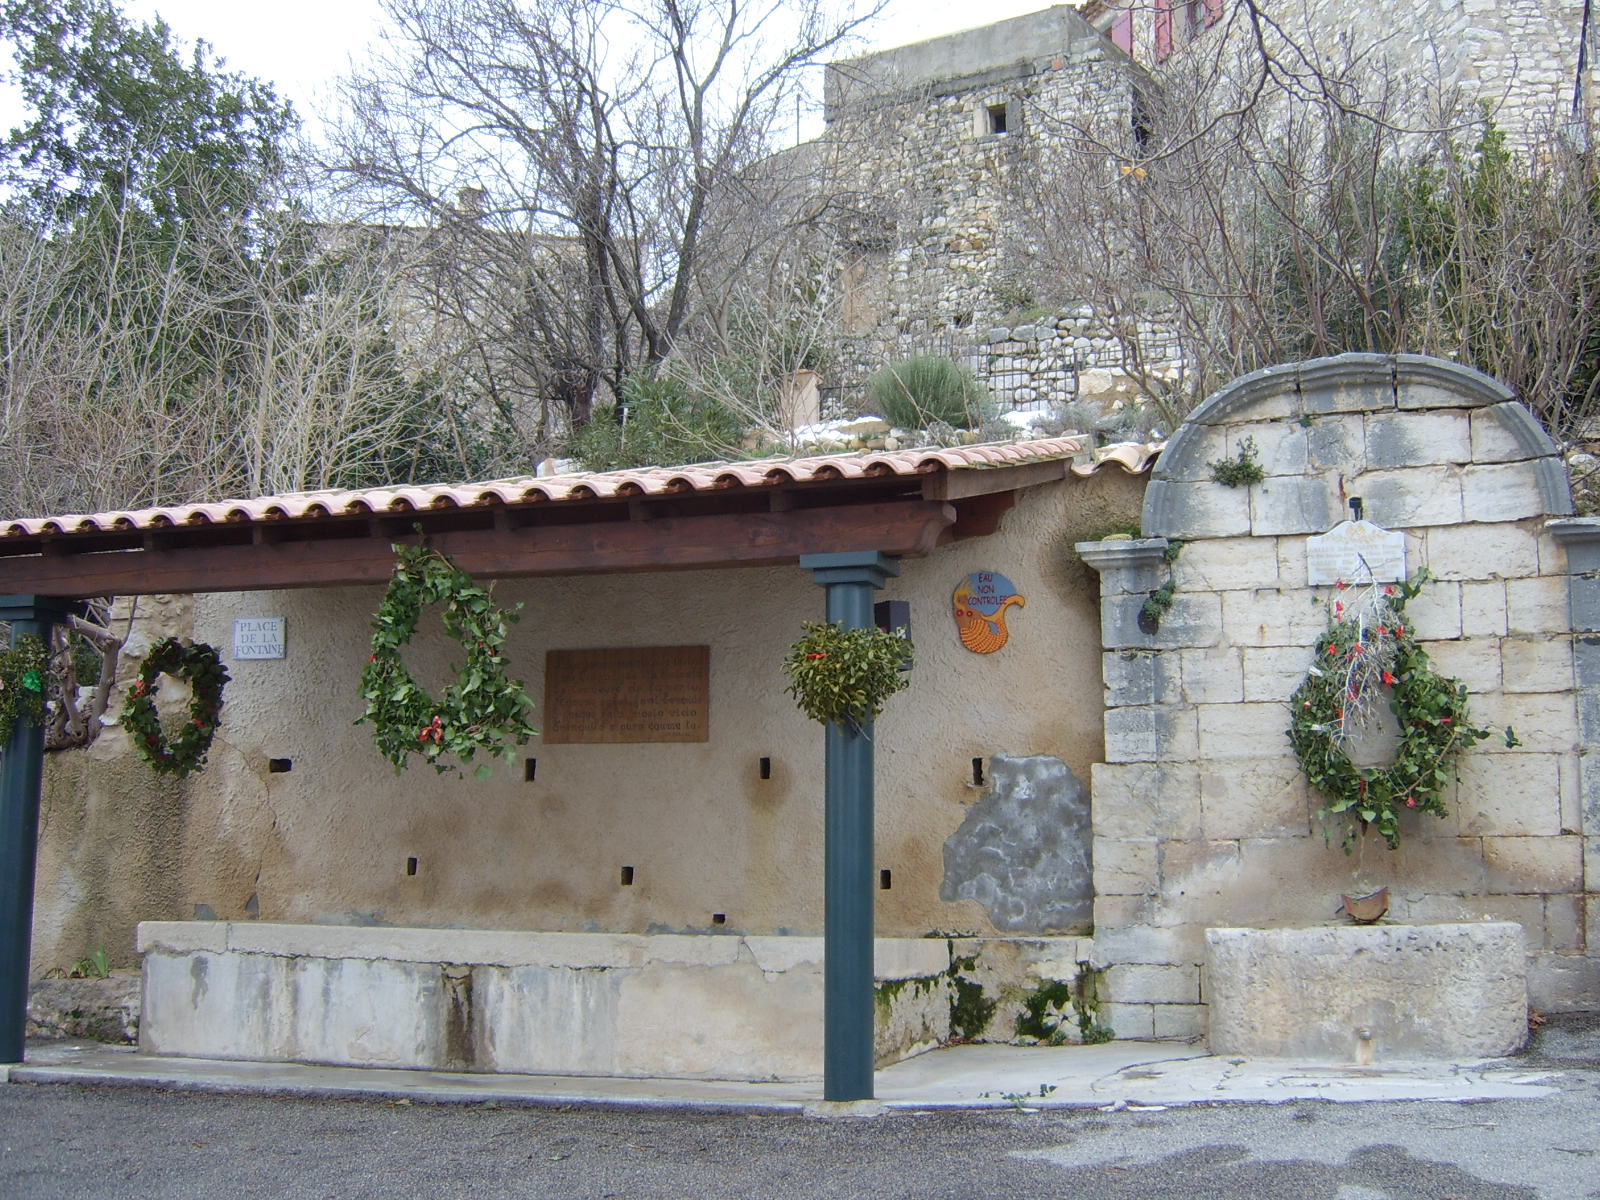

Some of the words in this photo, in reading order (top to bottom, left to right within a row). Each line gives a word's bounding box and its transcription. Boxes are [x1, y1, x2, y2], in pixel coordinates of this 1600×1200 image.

[978, 573, 993, 583] EAU
[978, 585, 994, 594] NON
[241, 622, 277, 631] PLACE
[241, 634, 256, 643] DE
[263, 633, 277, 642] LA
[236, 645, 284, 657] FONTAINE
